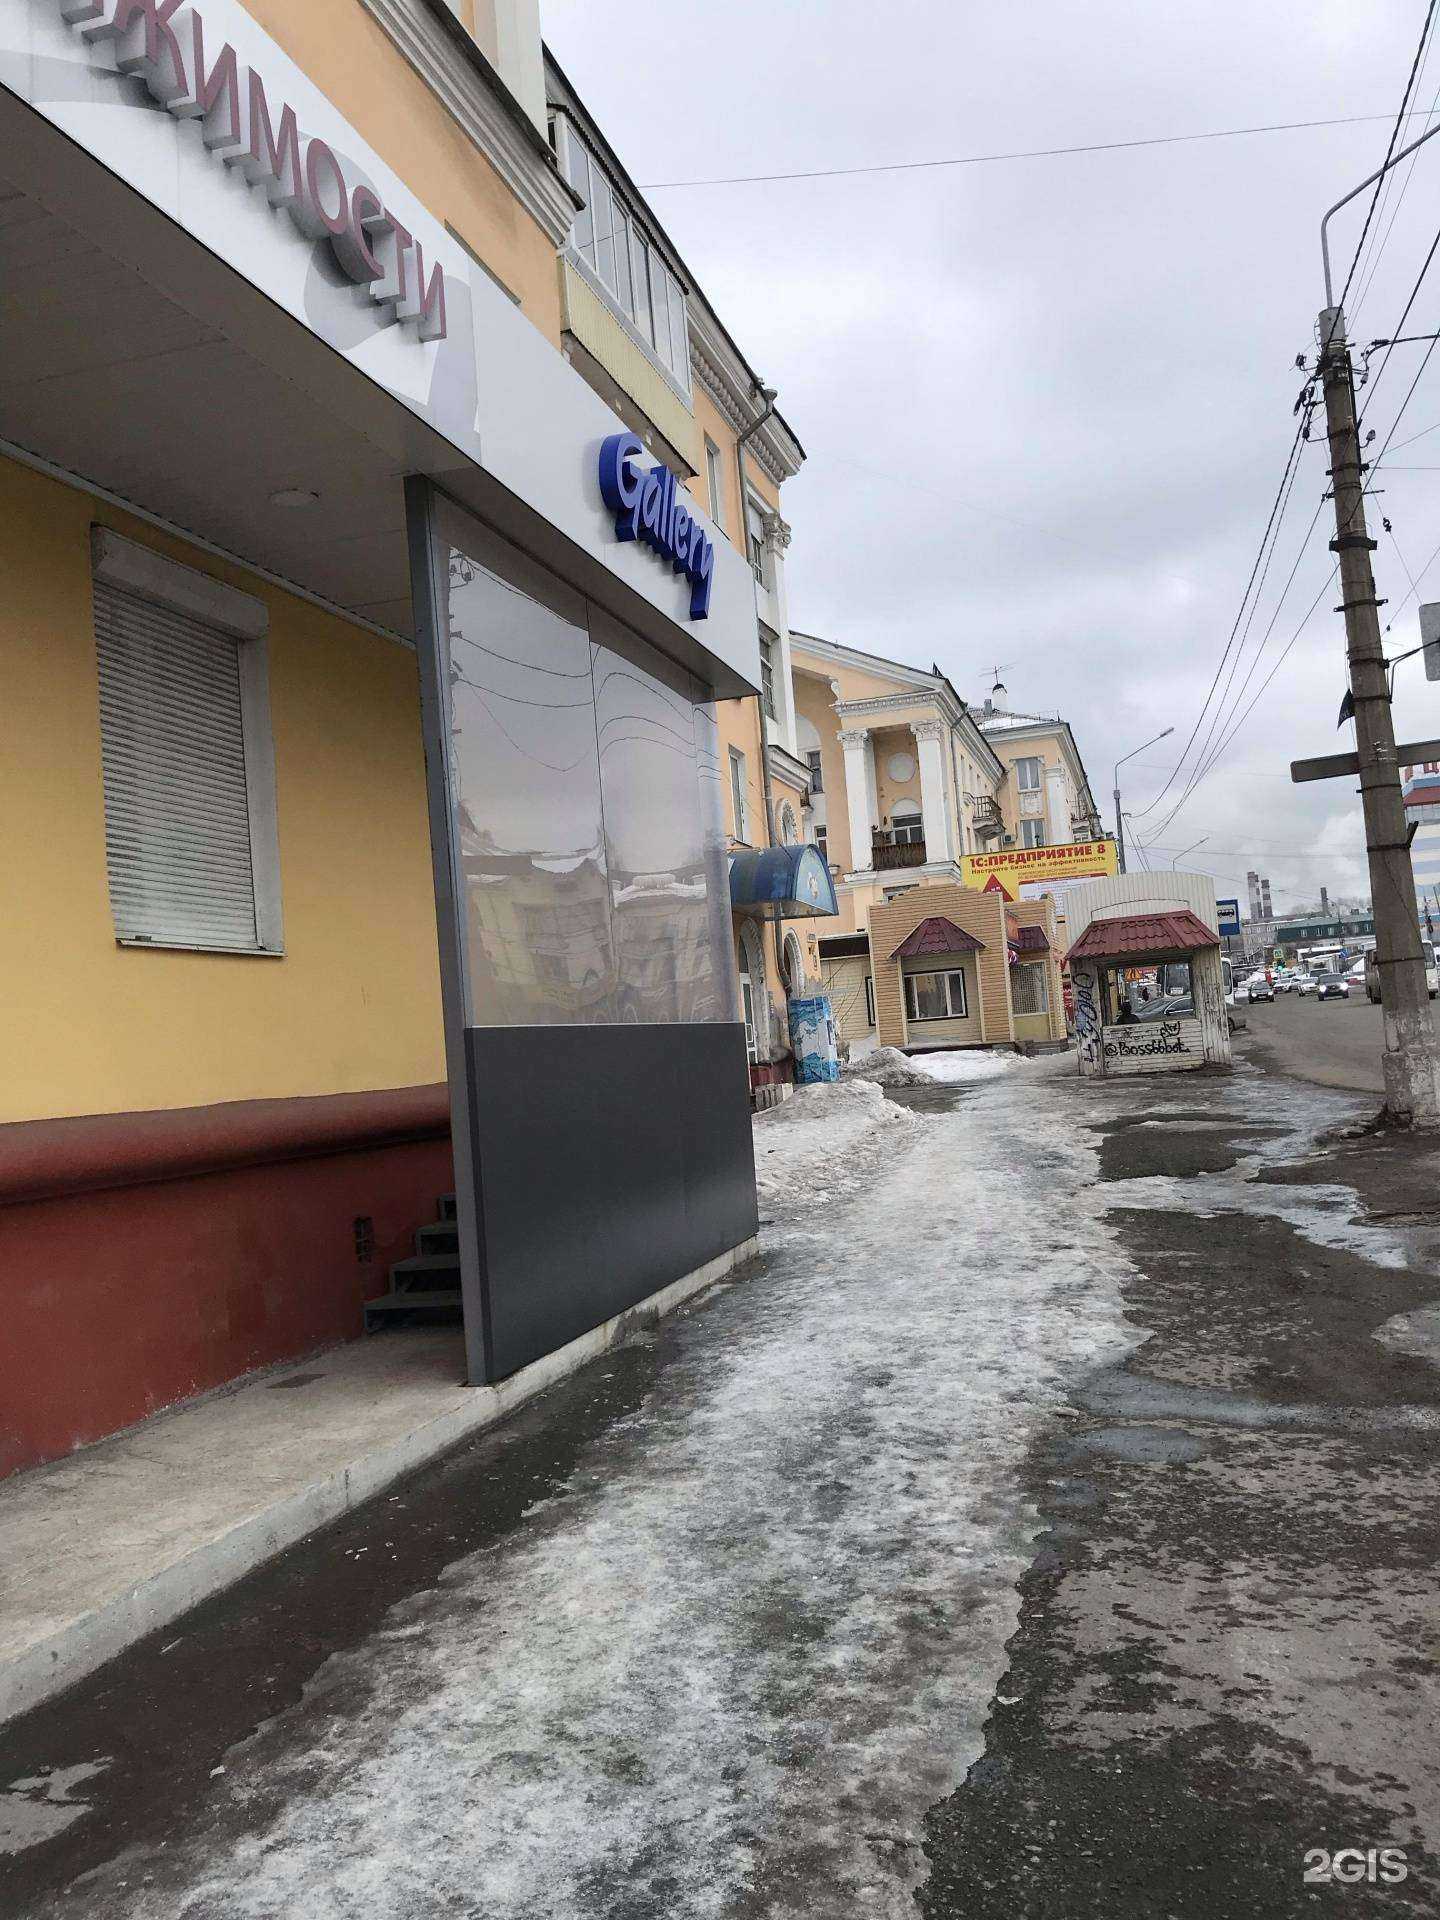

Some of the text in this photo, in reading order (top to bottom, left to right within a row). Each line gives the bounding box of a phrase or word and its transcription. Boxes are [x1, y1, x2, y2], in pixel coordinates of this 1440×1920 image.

[64, 0, 447, 341] ЖИМОСТИ
[598, 432, 715, 620] Gallery
[969, 843, 1106, 868] 1С:ПРЕДПРИЯТИЕ 8
[1010, 863, 1035, 871] бизнес
[1048, 856, 1106, 867] эффективность
